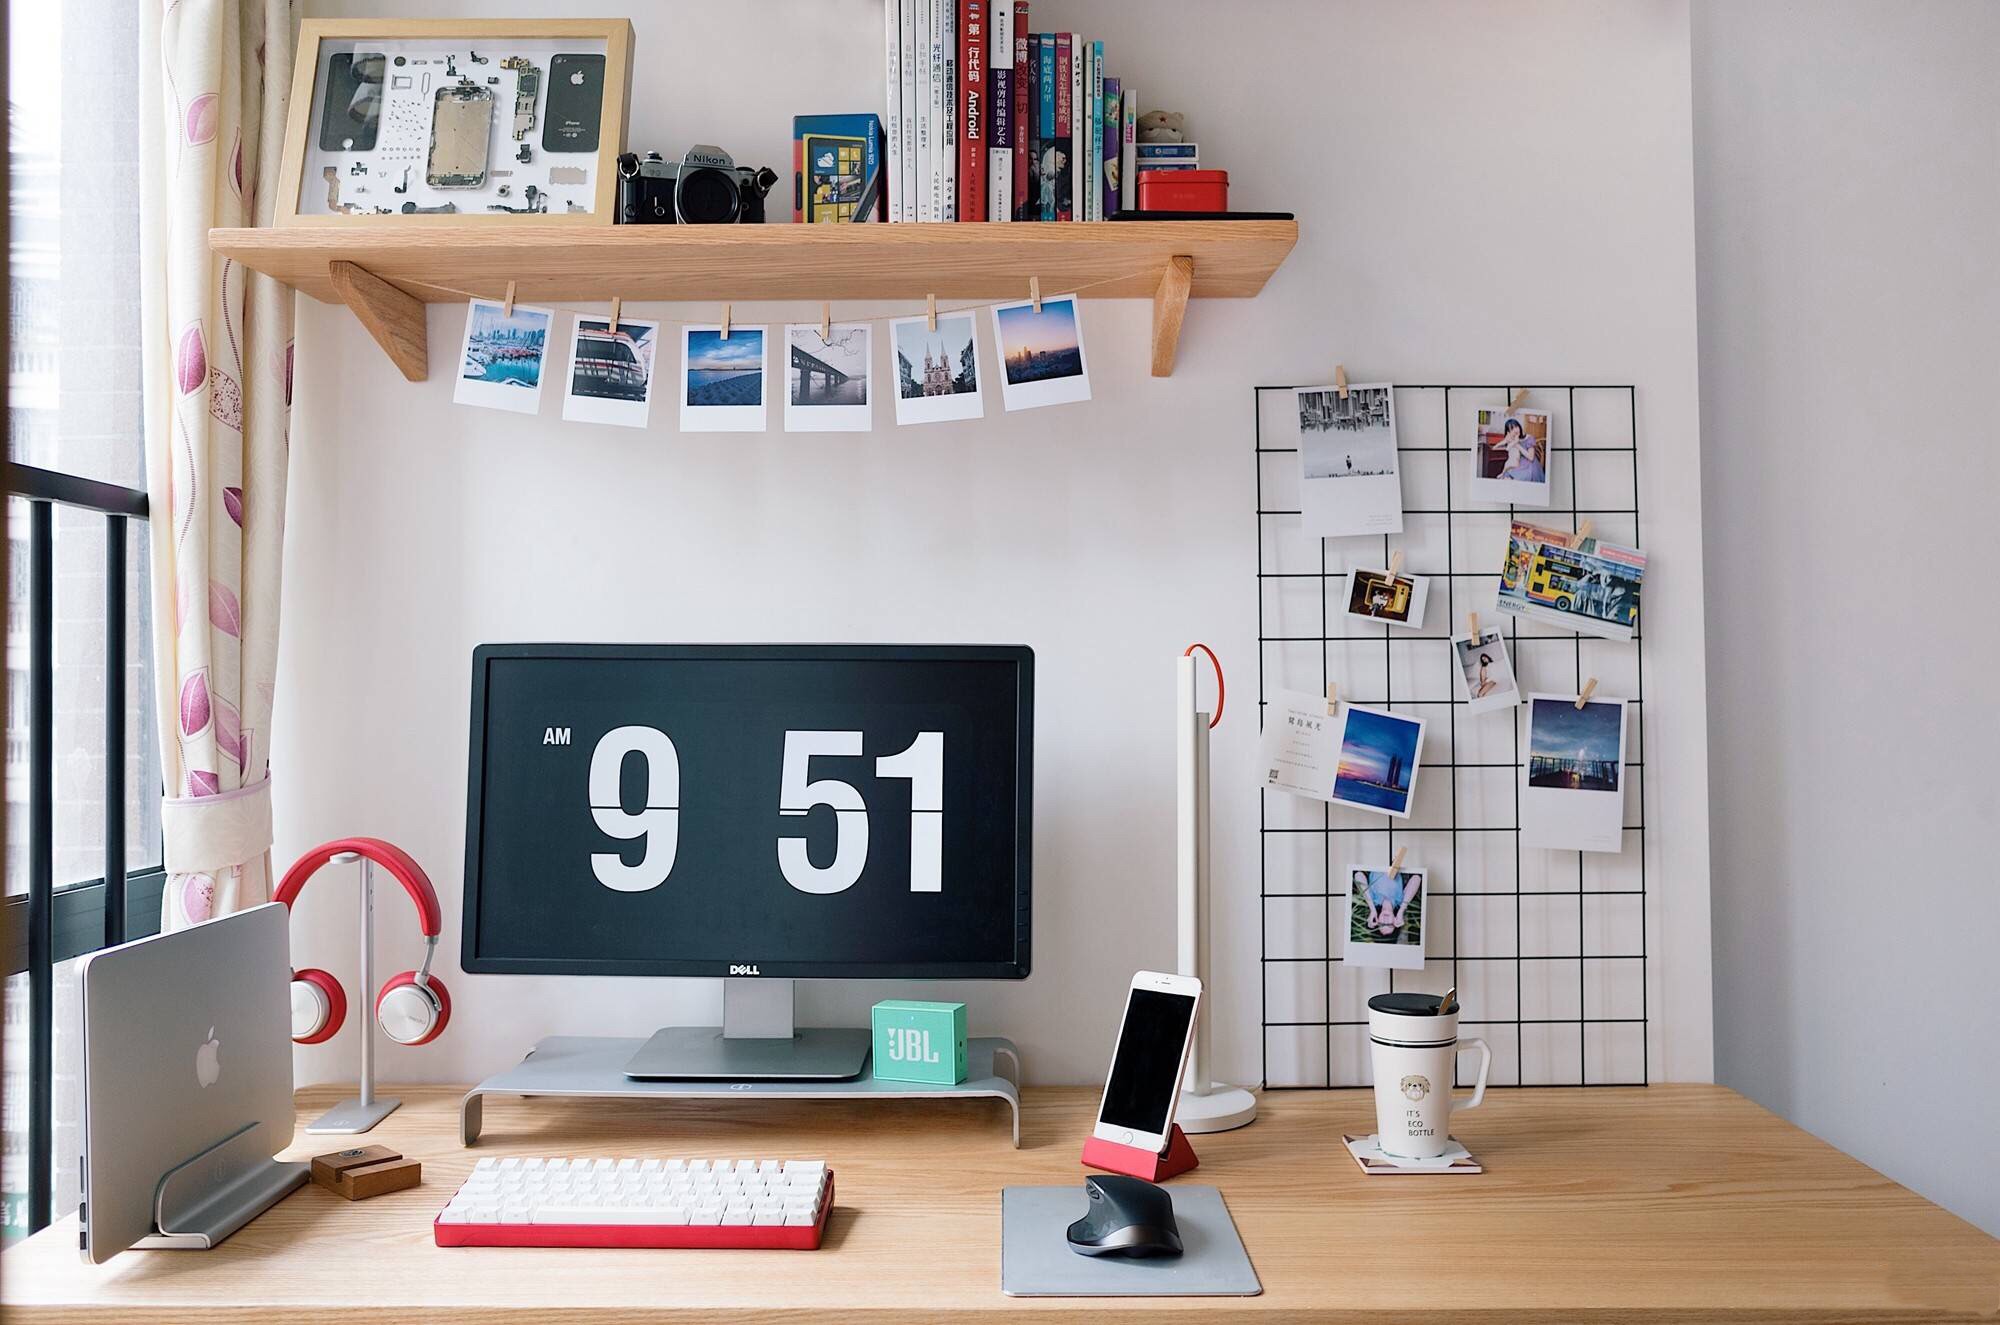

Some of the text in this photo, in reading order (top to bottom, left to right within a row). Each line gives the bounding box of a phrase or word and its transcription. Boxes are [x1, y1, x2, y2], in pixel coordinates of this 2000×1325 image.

[933, 43, 941, 83] 光纤通信
[968, 23, 980, 138] 第一行代码 Android
[1016, 38, 1028, 114] 微博改变一切
[1043, 56, 1052, 102] 海底两万里
[997, 70, 1006, 145] 影视剪辑编辑艺术
[1059, 56, 1068, 123] 钢铁是怎样炼成的
[693, 154, 726, 165] Nikon
[543, 726, 944, 894] AM 9 51
[730, 965, 760, 975] DELL
[888, 1028, 939, 1064] JBL
[1406, 1110, 1420, 1118] IT'S
[1408, 1120, 1423, 1128] ECO
